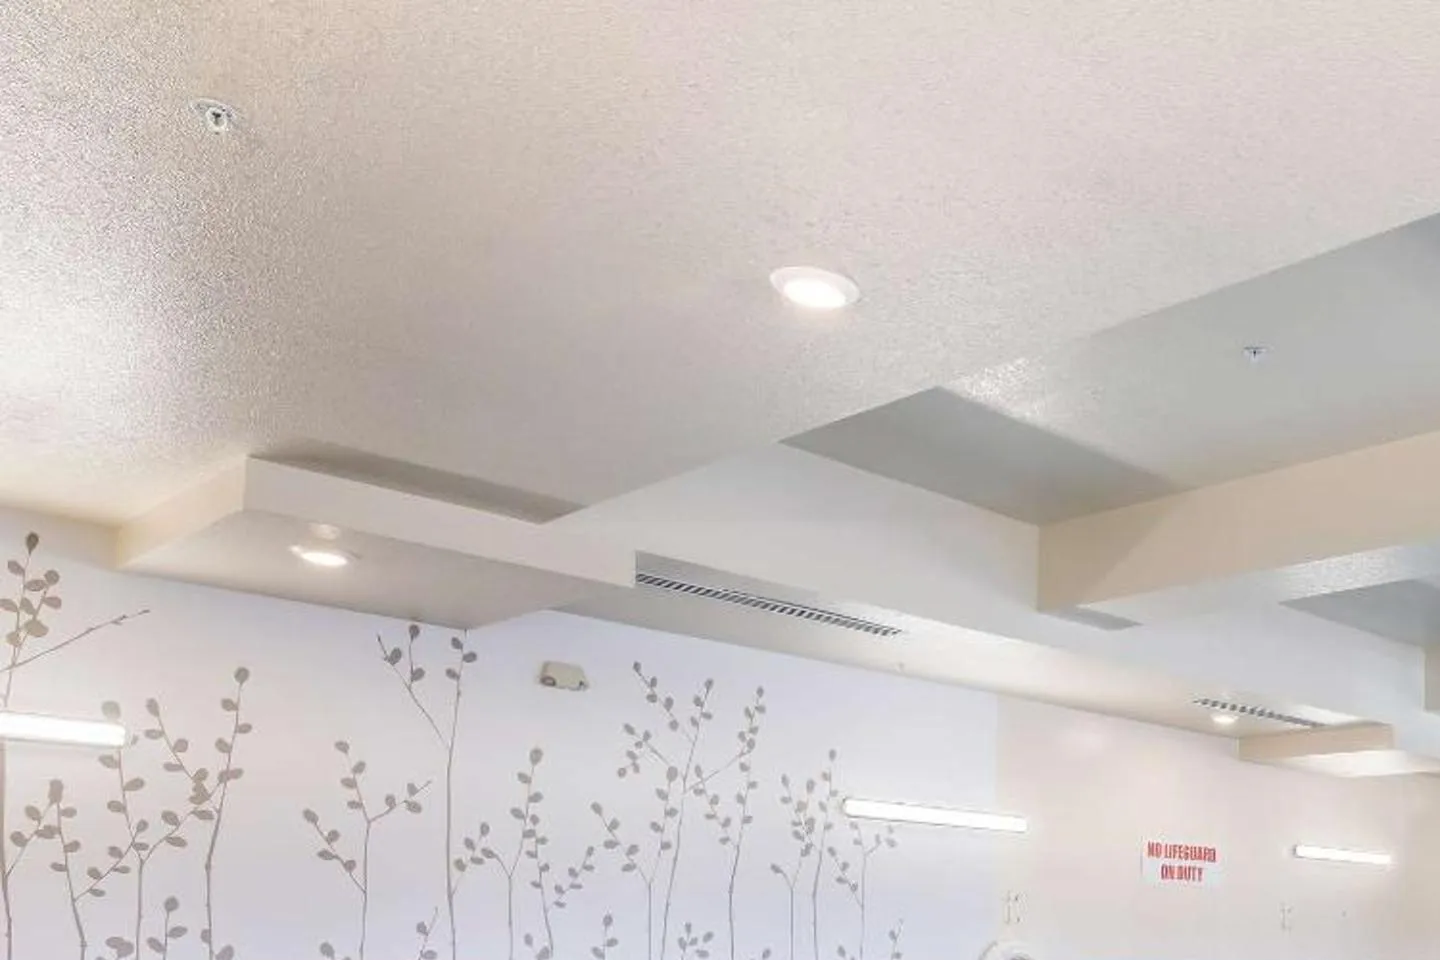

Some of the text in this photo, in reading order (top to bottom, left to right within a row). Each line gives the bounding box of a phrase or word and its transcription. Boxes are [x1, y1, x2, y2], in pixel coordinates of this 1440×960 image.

[1147, 840, 1216, 862] NO LIFEGUARD
[1161, 864, 1203, 882] ON DUTY
